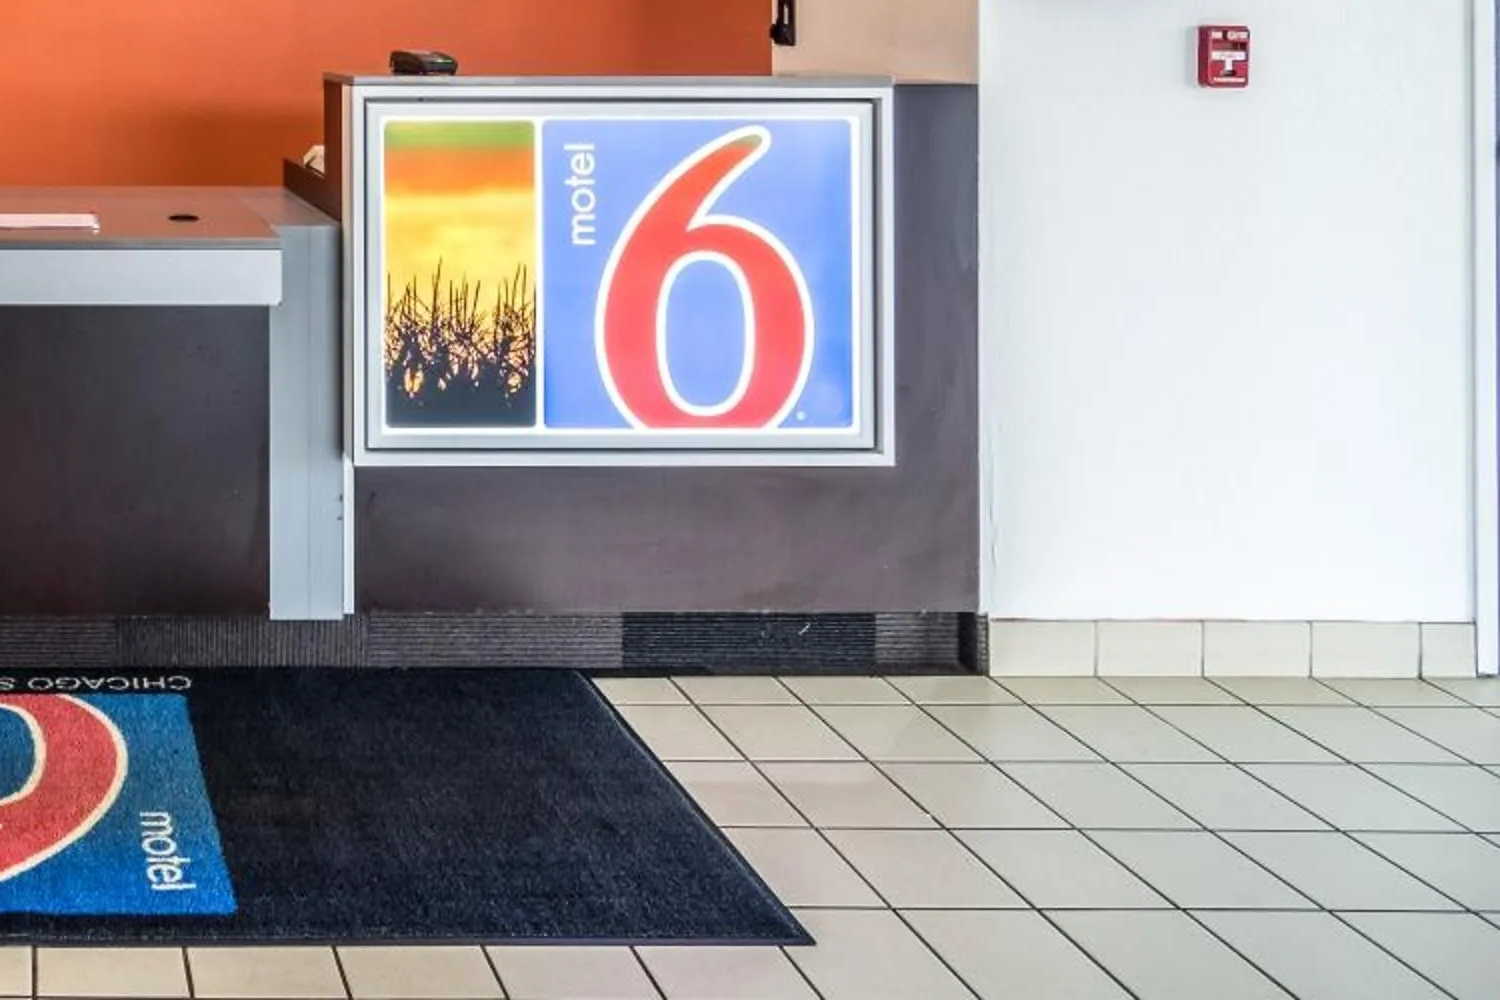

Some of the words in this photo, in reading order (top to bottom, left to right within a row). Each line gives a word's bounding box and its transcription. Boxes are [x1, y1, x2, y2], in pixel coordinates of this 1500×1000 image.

[563, 143, 596, 246] motel
[594, 125, 816, 430] 6
[27, 675, 192, 691] CHICAGO
[139, 810, 197, 892] motel
